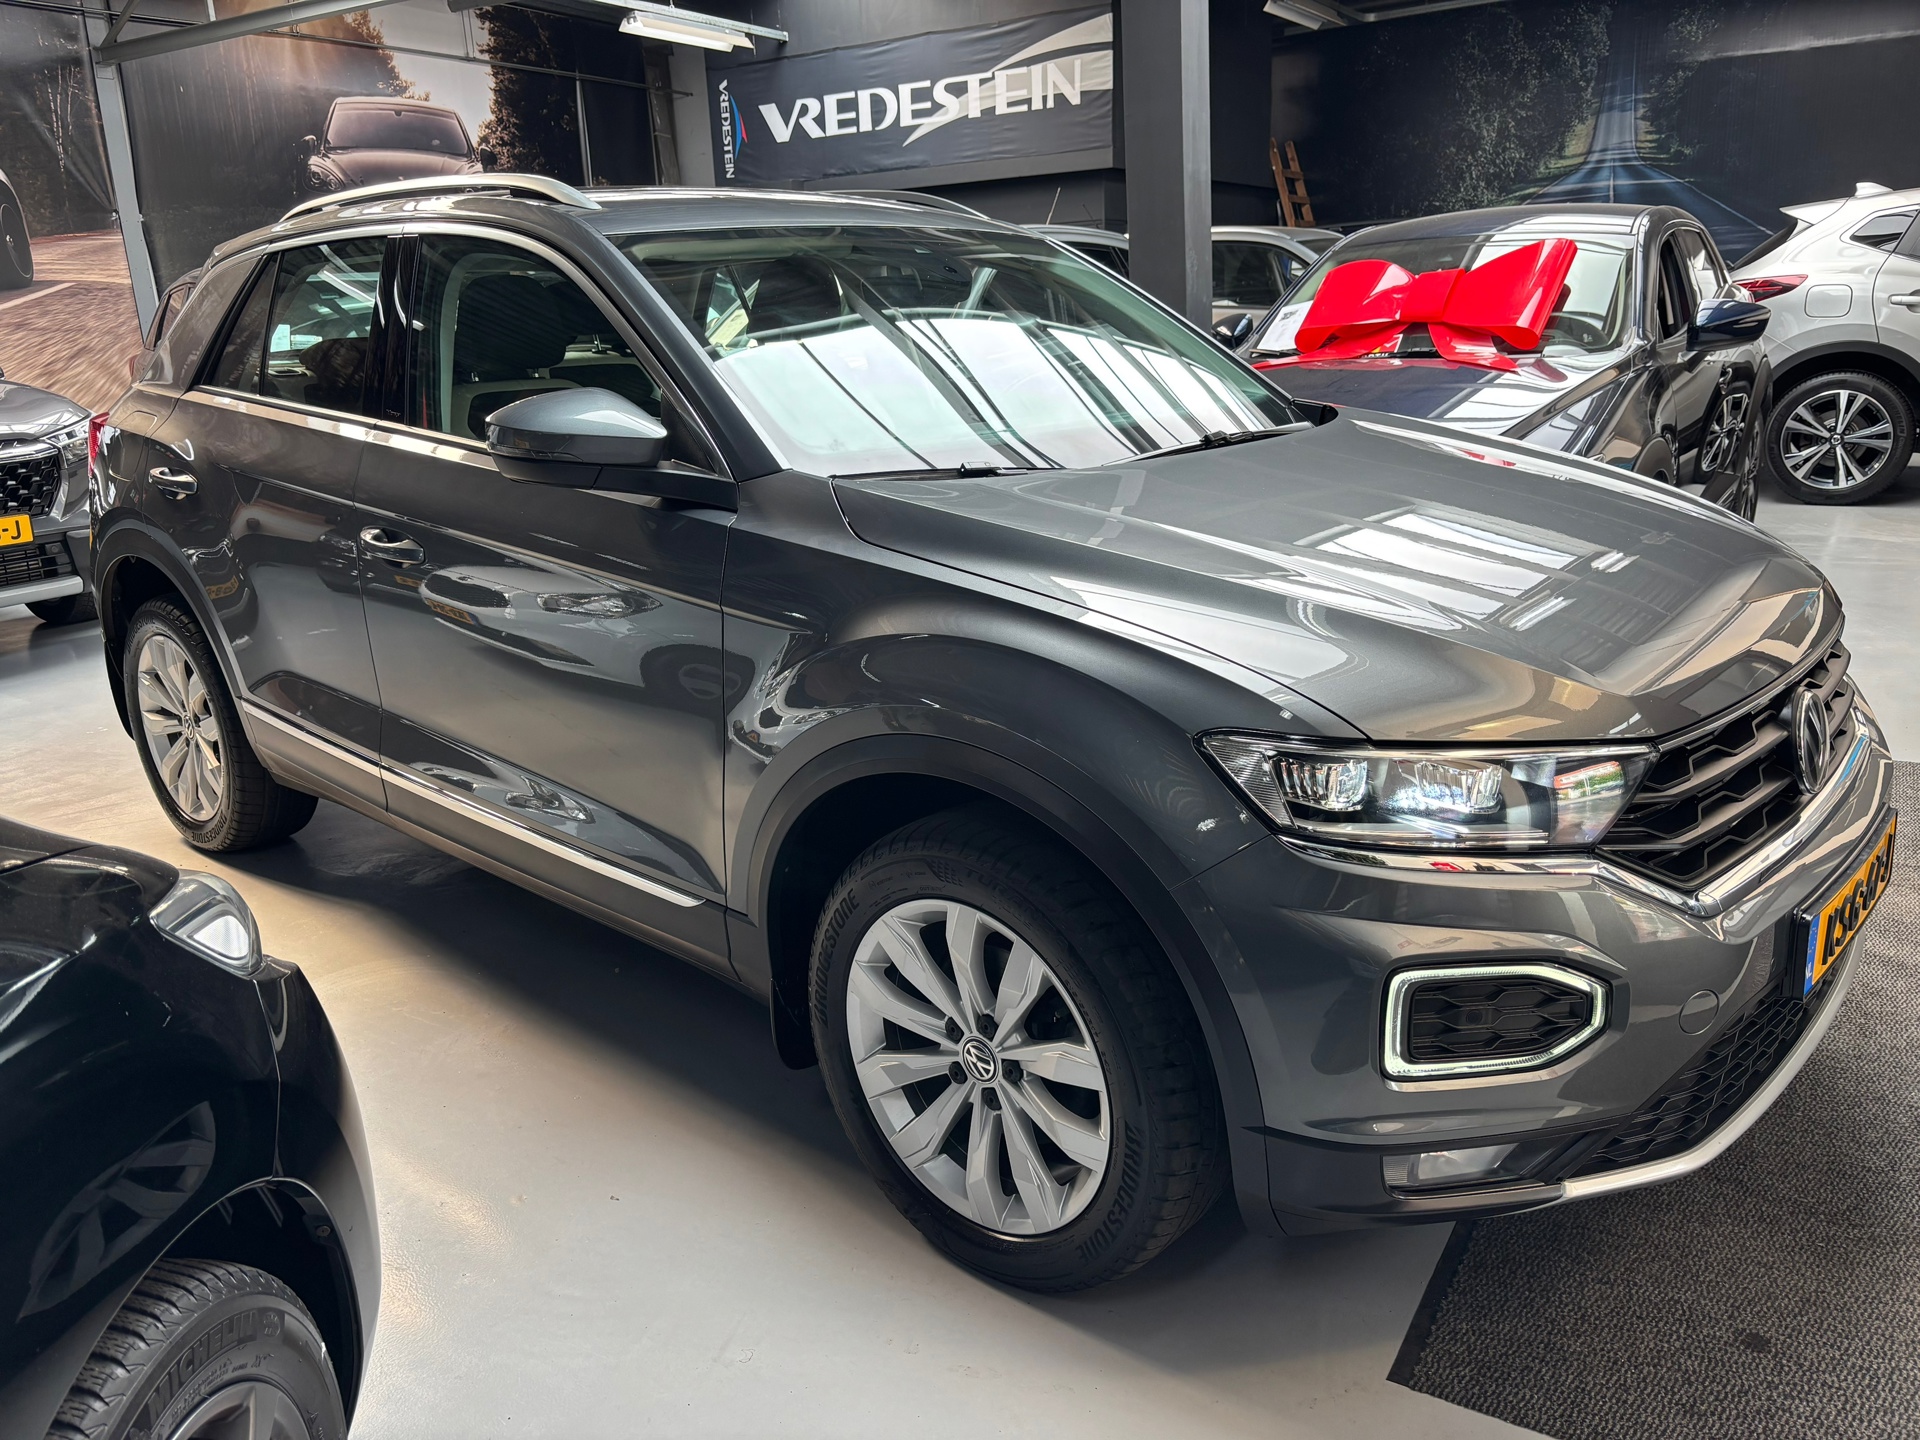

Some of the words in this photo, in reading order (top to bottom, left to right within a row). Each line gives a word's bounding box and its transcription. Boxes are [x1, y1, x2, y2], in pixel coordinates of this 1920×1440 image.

[719, 79, 735, 179] VREDESTEIN
[758, 59, 1081, 143] VREDESTEIN
[0, 519, 21, 542] -J
[814, 887, 860, 1030] BRIDGESTONE
[1075, 1120, 1146, 1266] BRIDGESTONE
[148, 1310, 257, 1425] MICHELIN
